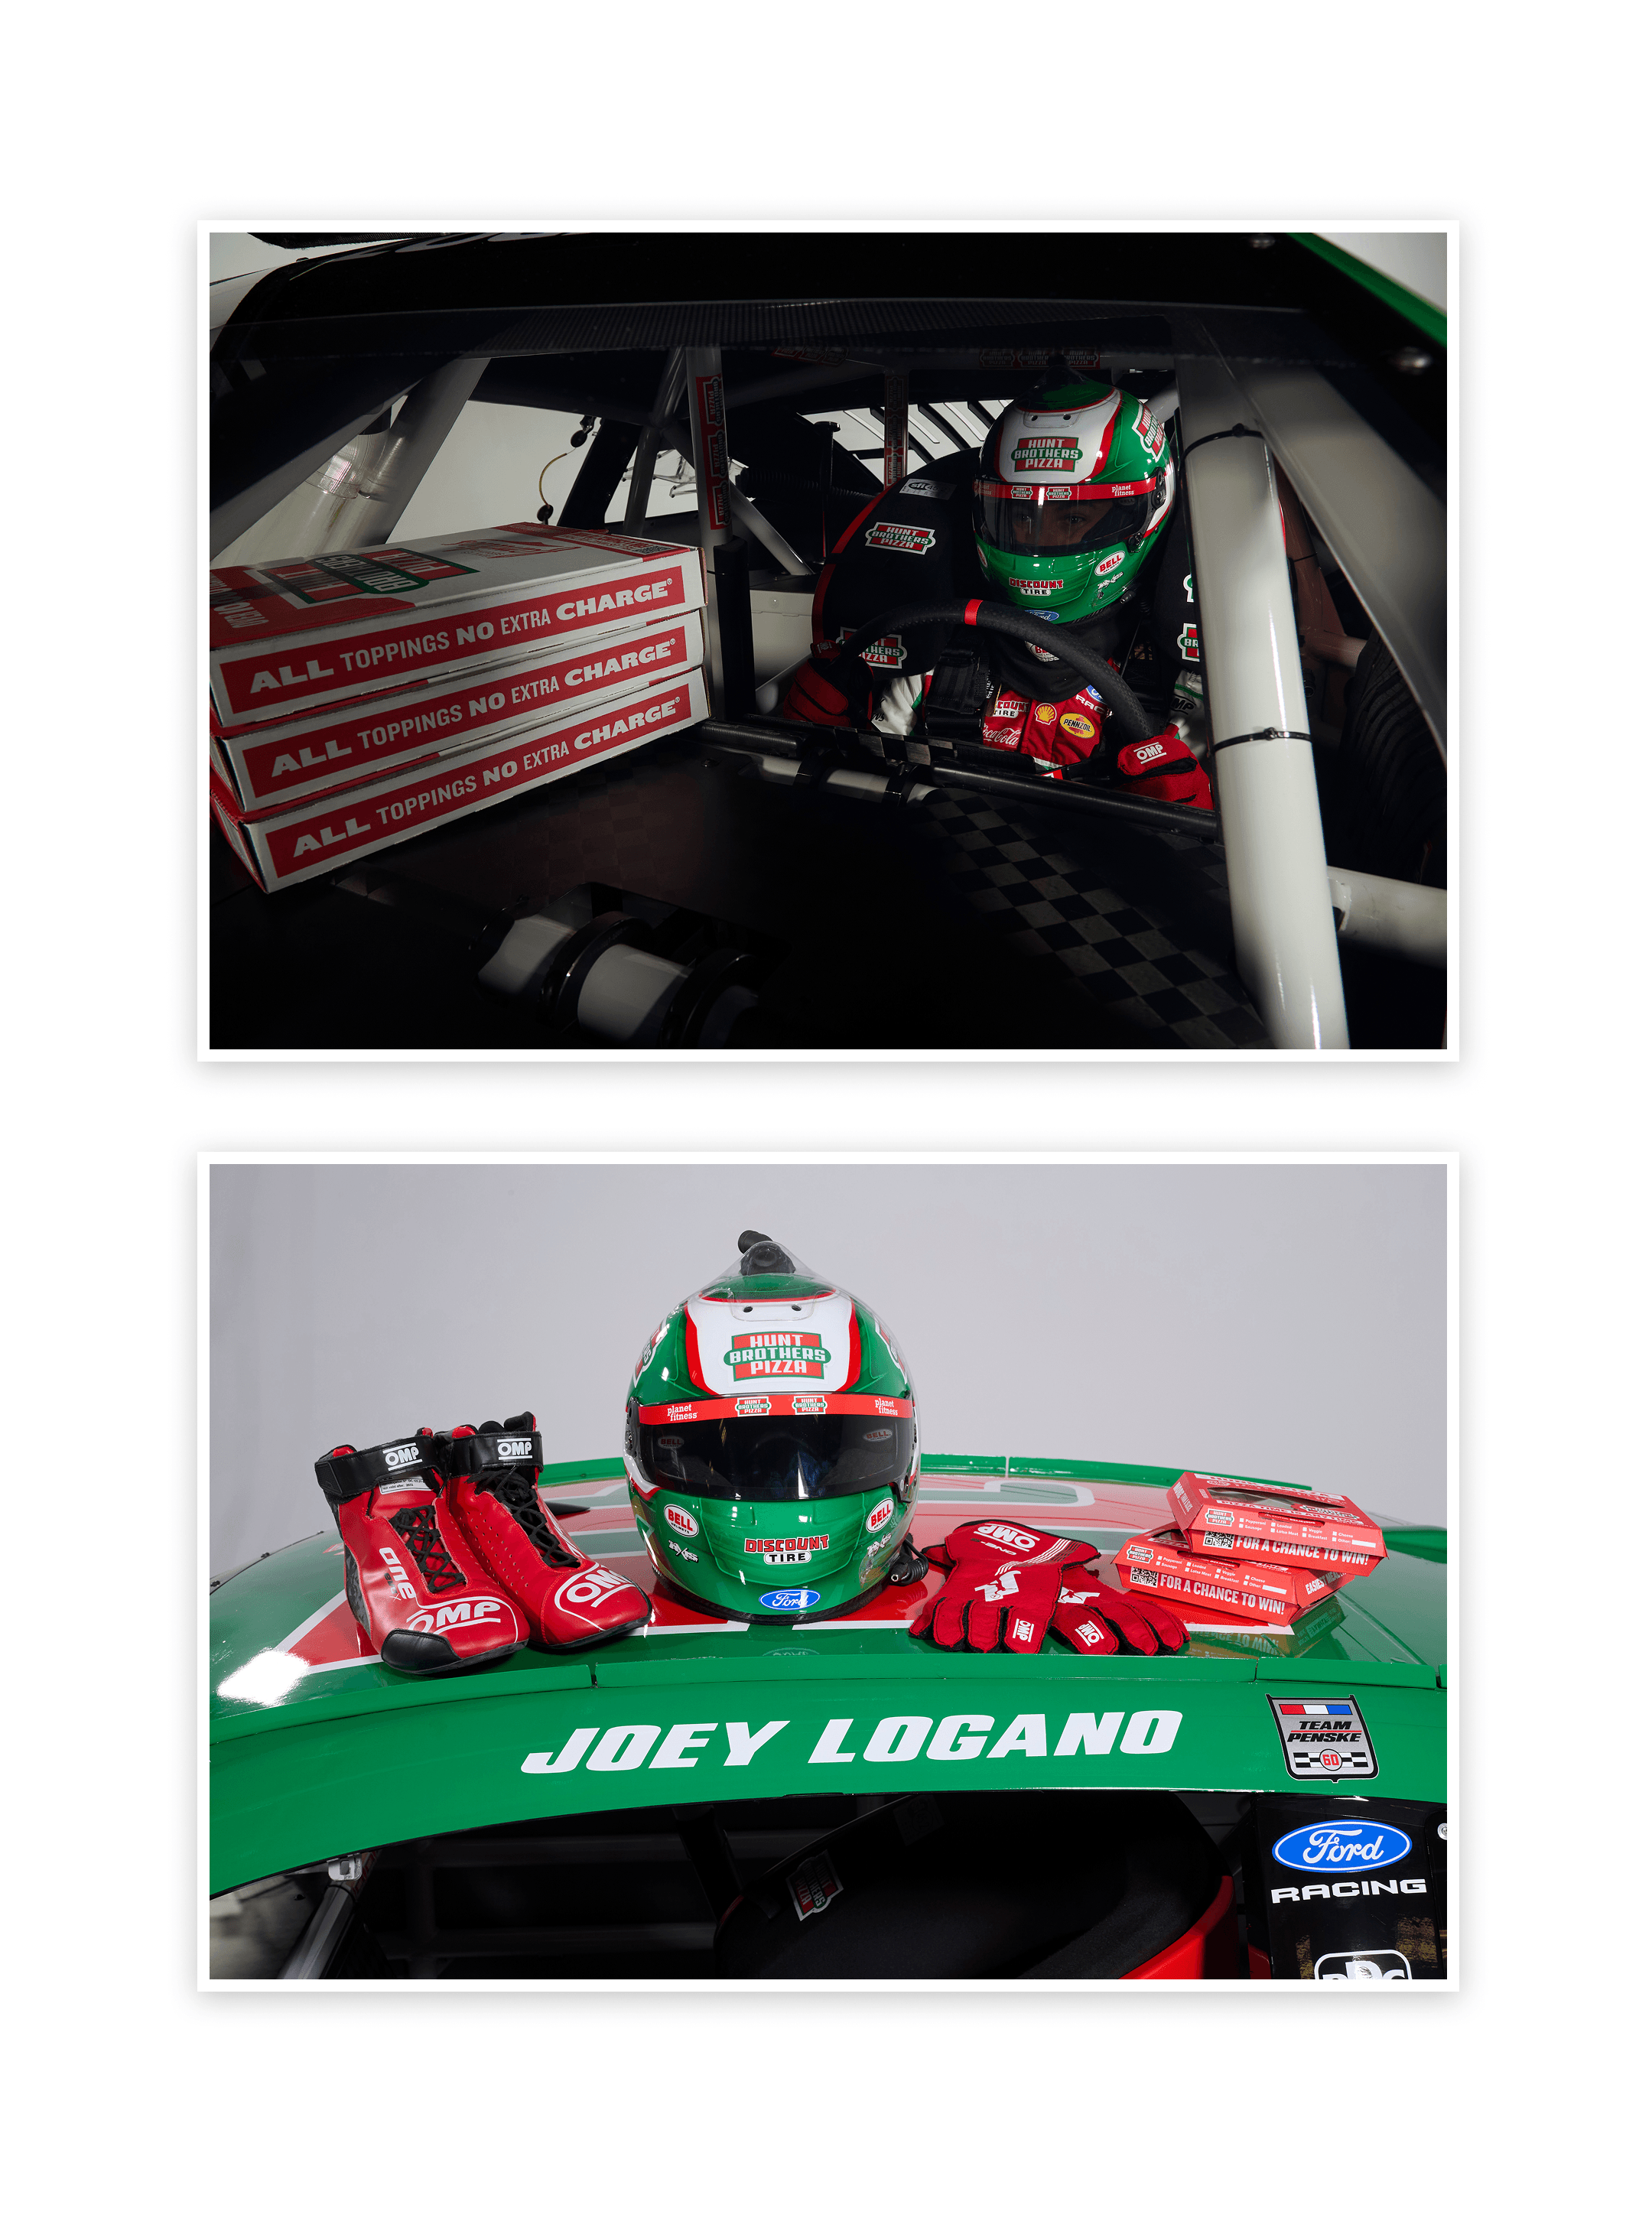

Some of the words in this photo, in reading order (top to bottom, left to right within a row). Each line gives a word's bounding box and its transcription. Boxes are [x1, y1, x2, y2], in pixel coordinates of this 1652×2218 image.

[1028, 439, 1065, 448] HUNT
[1014, 449, 1079, 459] BROTHERS
[1025, 458, 1063, 468] PIZZA
[1111, 484, 1131, 493] planet
[872, 531, 929, 544] BROTHERS
[886, 527, 919, 536] HUNT
[880, 538, 915, 548] PIZZA
[1100, 554, 1122, 572] BELL
[1010, 577, 1063, 588] DISCOUNT
[250, 660, 335, 693] ALL
[340, 633, 450, 672] TOPPINGS
[456, 622, 495, 646] NO
[501, 608, 551, 636] EXTRA
[997, 701, 1030, 712] COUNT
[1171, 698, 1195, 710] MP
[271, 740, 353, 777] ALL
[356, 704, 463, 750] TOPPINGS
[468, 692, 506, 717] NO
[511, 678, 560, 704] EXTRA
[1063, 718, 1091, 732] PENNZOIL
[1137, 743, 1164, 761] OMP
[293, 818, 371, 857] ALL
[376, 774, 477, 825] TOPPINGS
[483, 760, 518, 786] NO
[523, 741, 571, 772] EXTRA
[750, 1335, 803, 1348] HUNT
[730, 1347, 826, 1364] BROTHERS
[750, 1359, 807, 1374] PIZZA
[667, 1403, 691, 1416] planet
[875, 1398, 894, 1408] planet
[670, 1412, 698, 1421] fitness
[879, 1406, 898, 1416] fitness
[867, 1431, 891, 1439] BELL
[385, 1446, 419, 1466] OMP
[498, 1442, 532, 1458] OMP
[668, 1508, 694, 1532] BELL
[871, 1504, 891, 1527] BELL
[745, 1535, 828, 1552] DISCOUNT
[978, 1525, 1036, 1549] OMP
[769, 1553, 806, 1563] TIRE
[1129, 1550, 1152, 1559] BROTHERS
[1236, 1536, 1260, 1550] FOR
[1261, 1540, 1270, 1552] A
[1272, 1540, 1320, 1559] CHANCE
[1324, 1548, 1339, 1561] TO
[1341, 1551, 1370, 1565] WIN!
[1220, 1575, 1239, 1583] Breakfast
[1306, 1578, 1328, 1595] EASIEST
[772, 1592, 809, 1607] Ford
[1160, 1573, 1182, 1590] FOR
[1183, 1579, 1191, 1592] A
[1193, 1582, 1239, 1604] CHANCE
[1241, 1592, 1256, 1608] TO
[1259, 1596, 1286, 1615] WIN!
[408, 1602, 501, 1634] OMP
[1016, 1619, 1031, 1641] OMP
[1078, 1623, 1098, 1644] OMP
[1299, 1721, 1352, 1730] TEAM
[520, 1720, 791, 1774] JOEY
[807, 1710, 1183, 1764] LOGANO
[1286, 1733, 1361, 1742] PENSKE
[1322, 1753, 1340, 1766] 60
[1302, 1829, 1384, 1864] Ford
[816, 1862, 832, 1889] HUNT
[795, 1879, 812, 1905] PIZZA
[803, 1862, 826, 1907] BROTHERS
[1270, 1878, 1427, 1904] RACING
